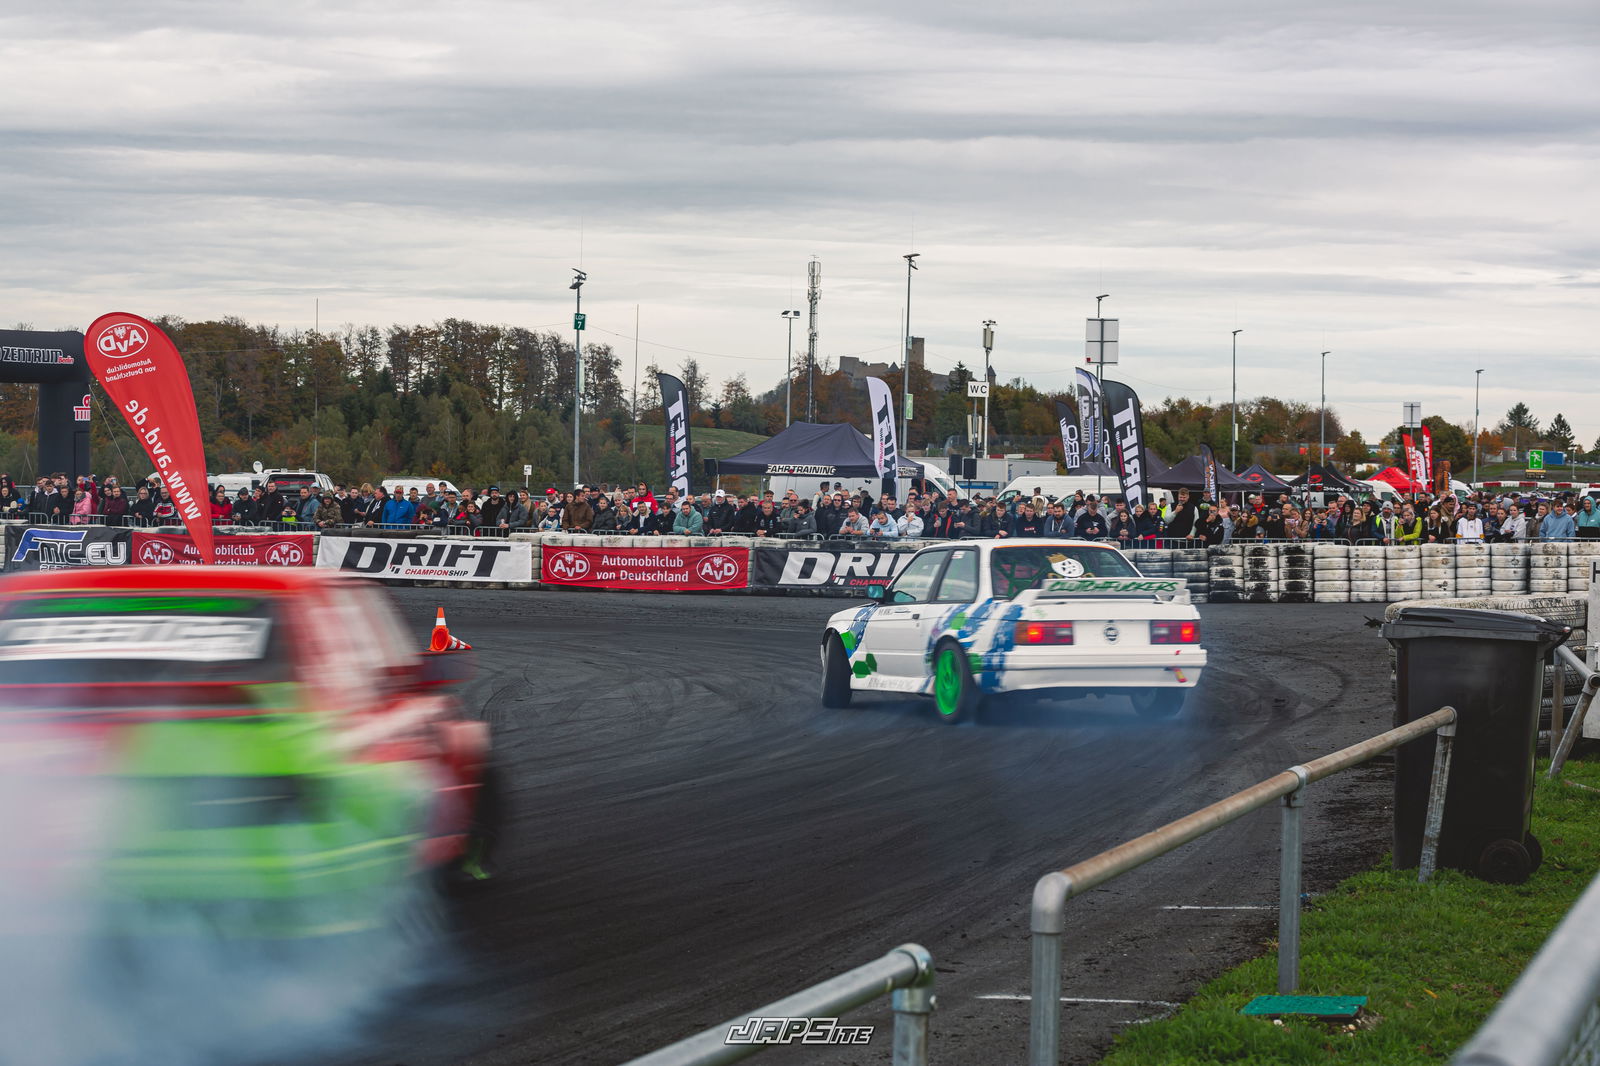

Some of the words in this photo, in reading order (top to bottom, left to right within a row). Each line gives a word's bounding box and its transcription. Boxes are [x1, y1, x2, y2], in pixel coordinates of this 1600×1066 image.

[577, 321, 583, 329] 7
[970, 385, 988, 394] WC
[340, 541, 511, 577] DRIFT
[601, 555, 684, 568] Automobilclub
[404, 568, 469, 577] CHAMPIONSHIP
[596, 571, 616, 580] von
[619, 570, 689, 583] Deutschland
